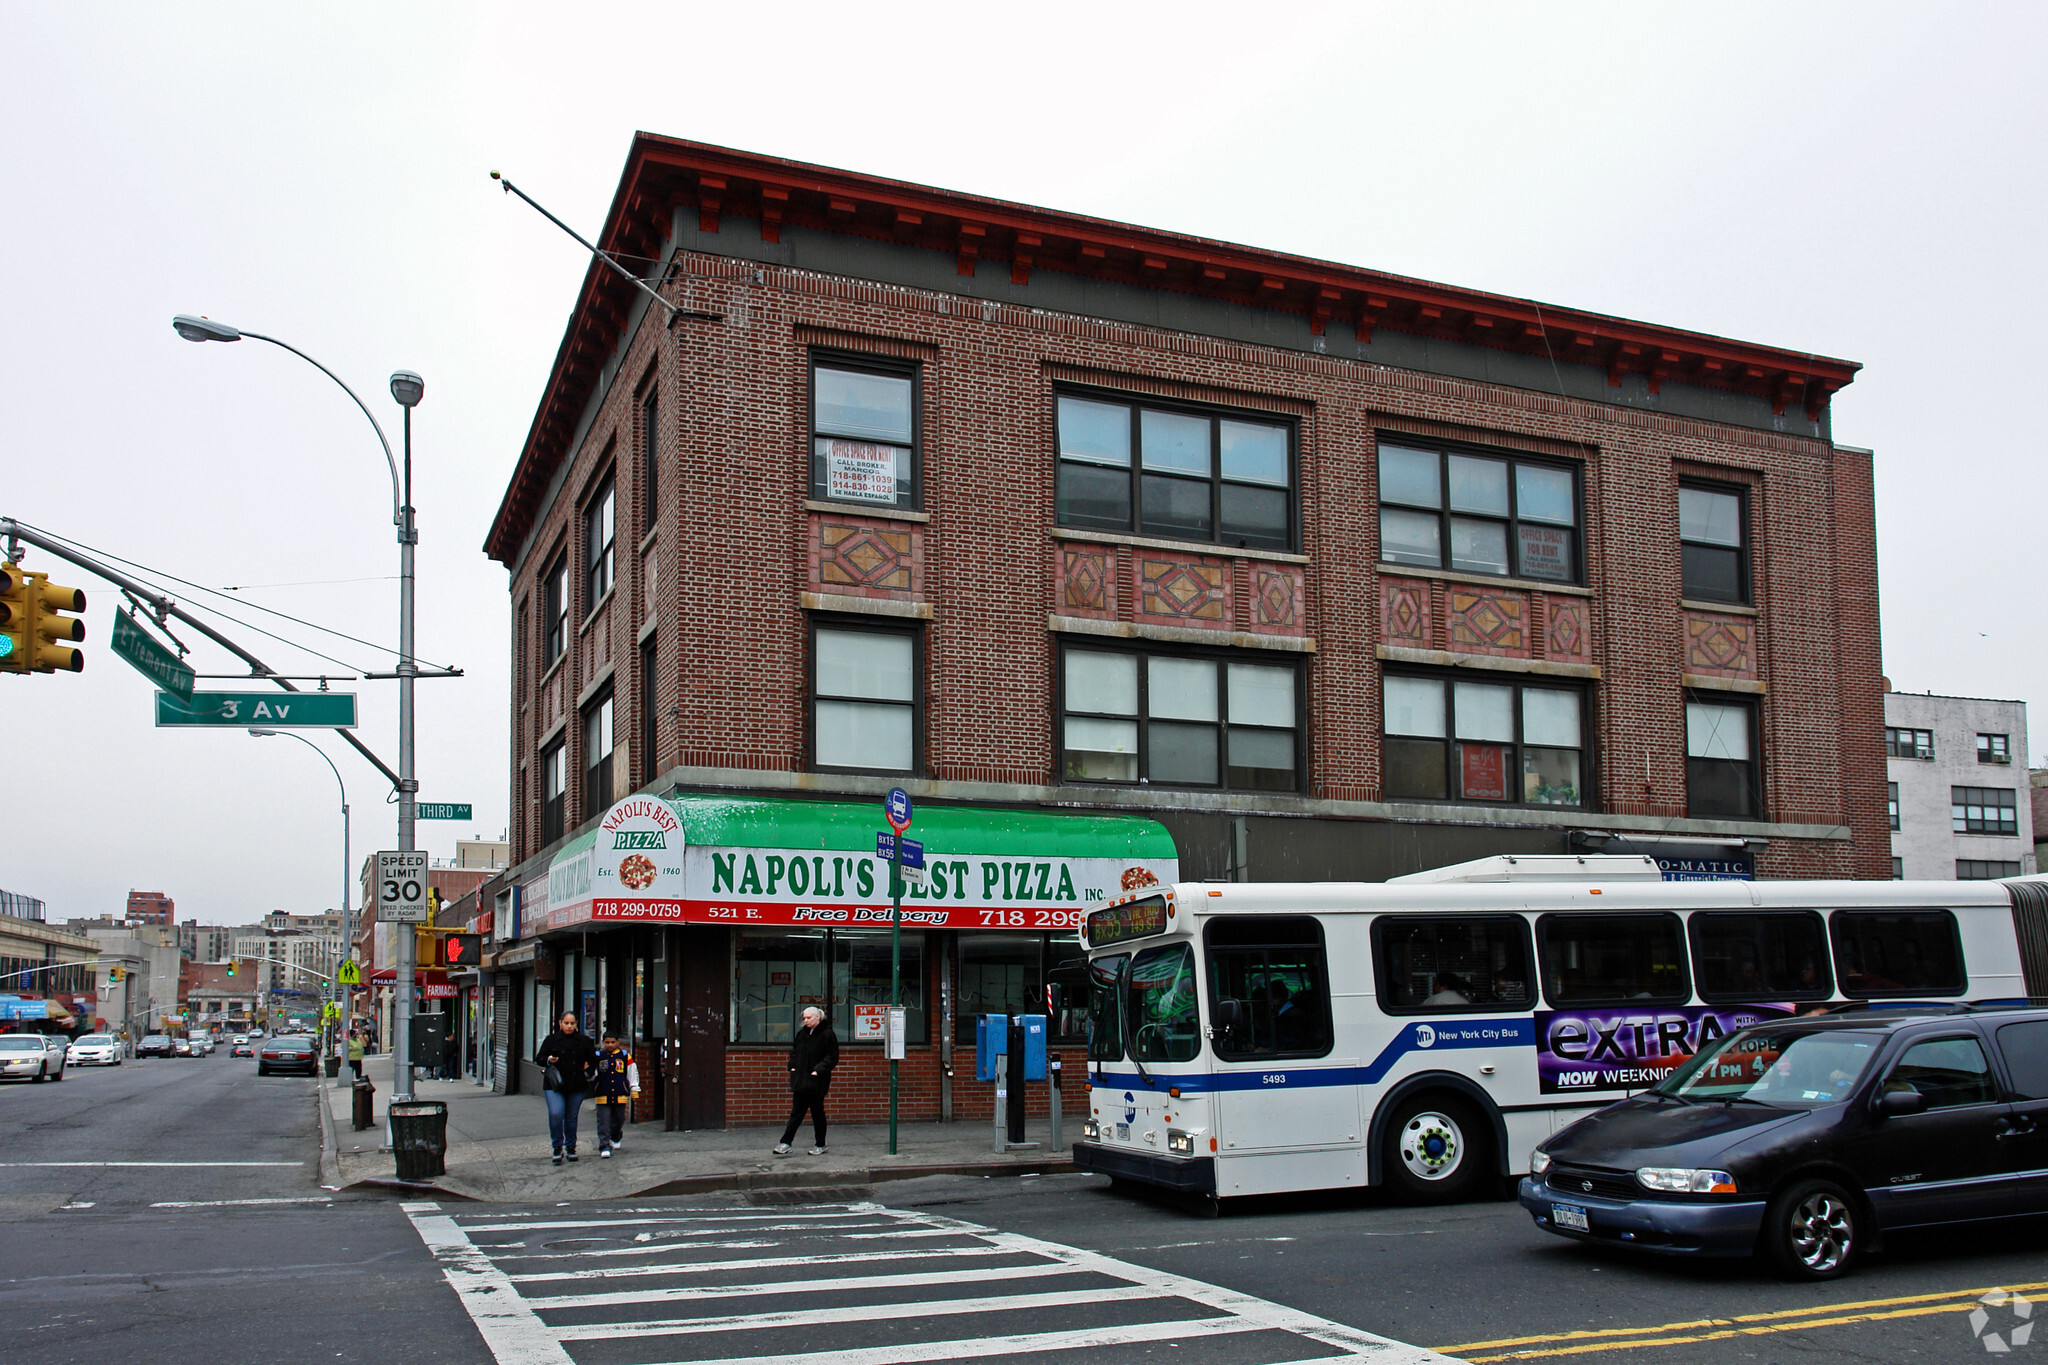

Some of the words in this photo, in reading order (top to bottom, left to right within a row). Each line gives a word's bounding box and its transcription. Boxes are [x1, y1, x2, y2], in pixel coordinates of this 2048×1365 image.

[832, 471, 892, 483] 718-861-1039
[843, 490, 863, 498] HABLA
[1520, 528, 1542, 542] OFFICE
[1543, 530, 1563, 544] SPACE
[1527, 543, 1540, 555] FOR
[1542, 544, 1558, 557] RENT
[121, 623, 129, 647] E
[130, 631, 171, 682] Tremont
[171, 668, 186, 690] Av
[222, 700, 238, 718] 3
[252, 701, 290, 718] Av
[420, 804, 453, 818] THIRD
[457, 805, 469, 813] AV
[602, 801, 652, 834] NAPOLI'S
[651, 806, 678, 833] BEST
[613, 831, 667, 849] PIZZA
[878, 835, 895, 847] BX15
[877, 848, 895, 859] BX55
[381, 856, 424, 867] SPEED
[385, 869, 418, 878] LIMIT
[598, 868, 614, 876] Est.
[662, 867, 680, 875] 1960
[711, 852, 875, 899] NAPOLI'S
[980, 862, 1077, 902] PIZZA
[1084, 887, 1106, 901] INC.
[382, 880, 421, 902] 30
[596, 902, 618, 916] 718
[620, 902, 681, 918] 299-0759
[708, 907, 739, 919] 521
[745, 908, 762, 919] E.
[792, 906, 848, 921] Free
[852, 908, 949, 925] Delivery
[979, 909, 1026, 927] 718
[427, 985, 458, 997] FARMACIA
[1439, 1031, 1458, 1041] New
[1460, 1030, 1480, 1040] York
[1482, 1029, 1500, 1040] City
[1502, 1028, 1519, 1038] Bus
[1262, 1074, 1286, 1084] 5493
[1558, 1071, 1598, 1086] NOW
[1708, 1058, 1719, 1078] 7
[1720, 1064, 1742, 1077] PM
